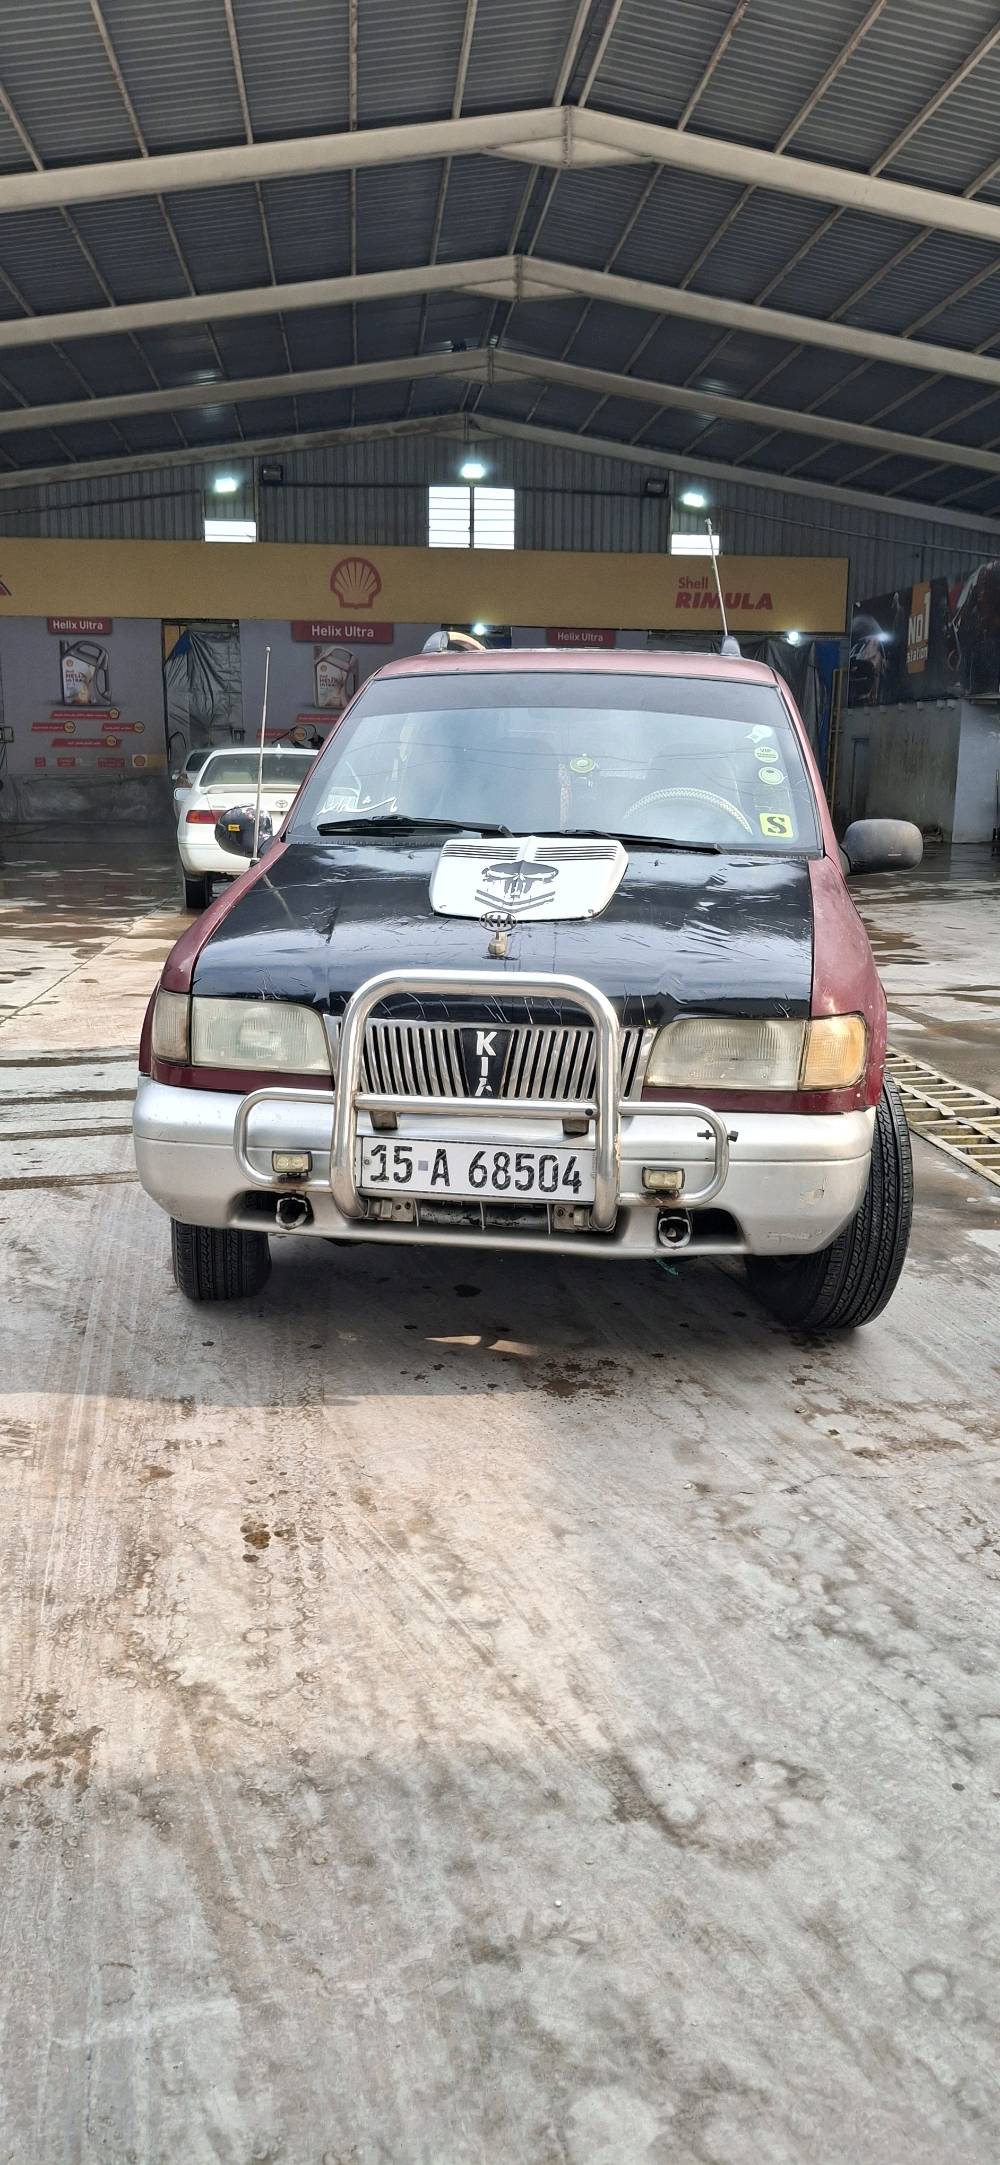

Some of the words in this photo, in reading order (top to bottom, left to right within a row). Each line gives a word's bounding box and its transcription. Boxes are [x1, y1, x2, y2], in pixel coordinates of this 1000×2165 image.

[678, 577, 708, 590] Shell
[675, 592, 773, 610] RIMULA
[53, 620, 77, 630] Helix
[80, 621, 103, 630] Ultra
[312, 625, 341, 636] Helix
[345, 626, 375, 637] Ultra
[557, 631, 580, 641] Helix
[582, 632, 604, 642] Ultra
[766, 816, 787, 834] S
[483, 914, 515, 928] KIA
[468, 1150, 582, 1194] 68504
